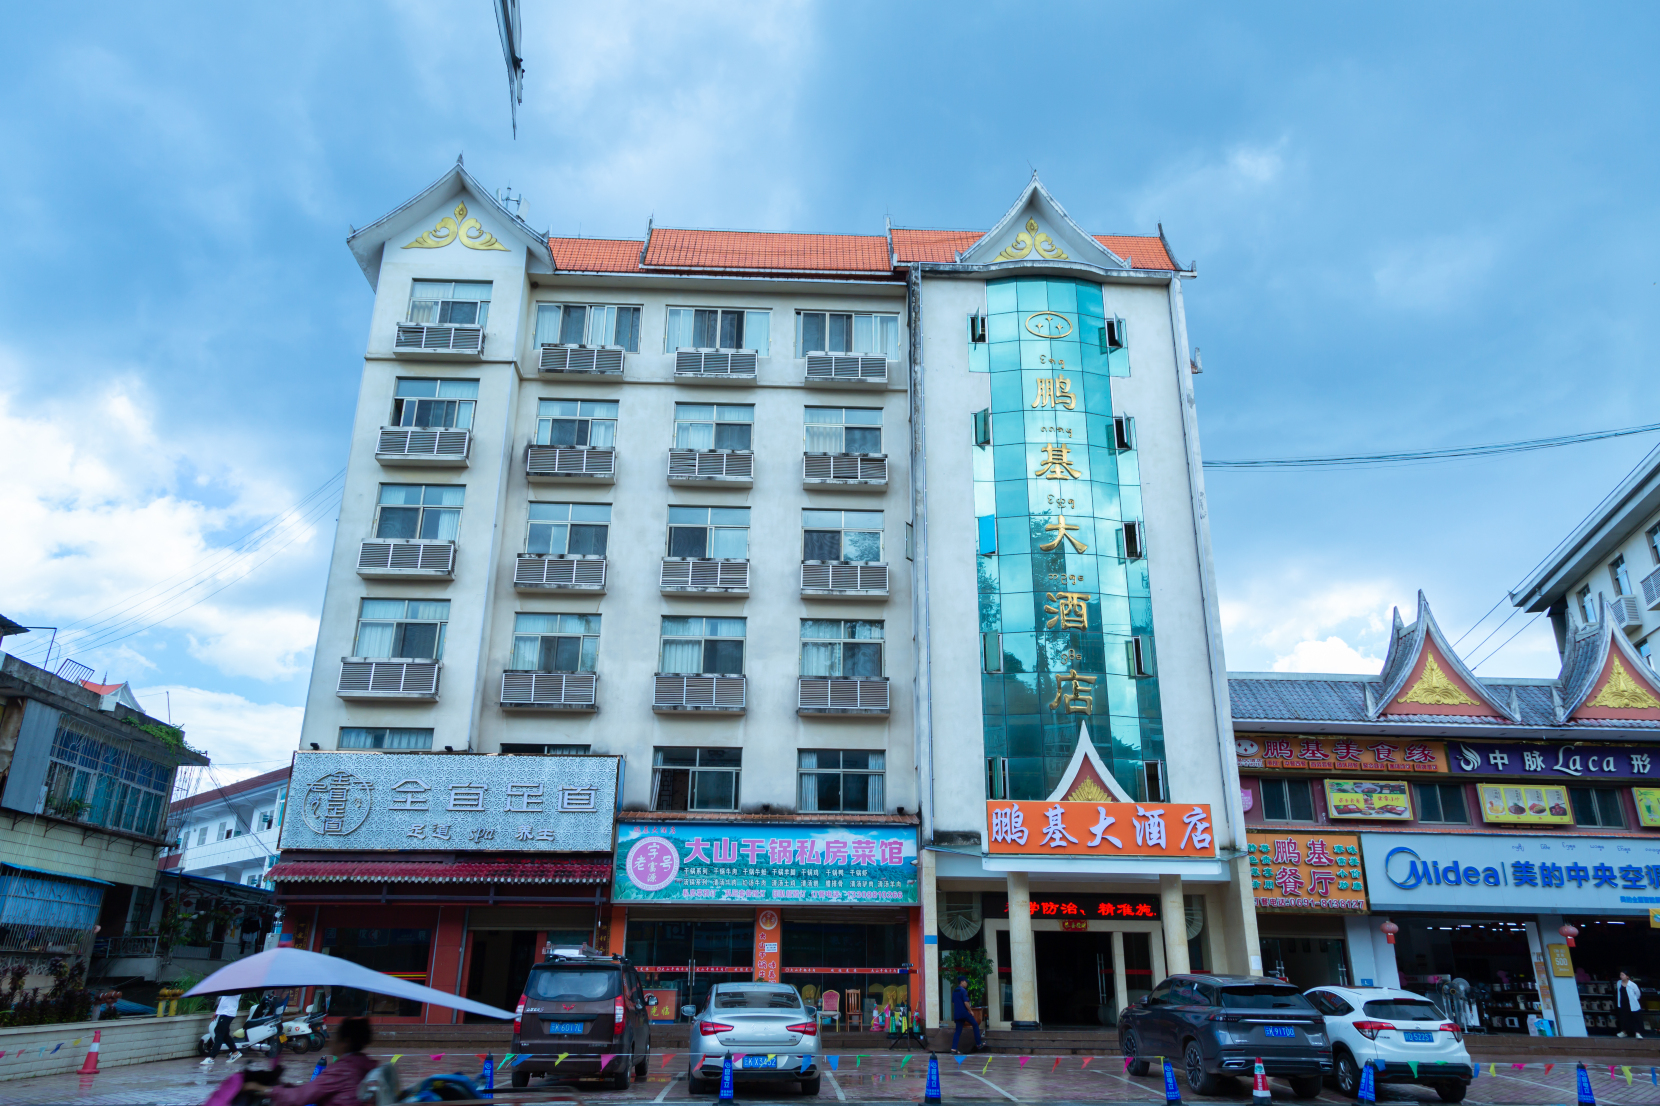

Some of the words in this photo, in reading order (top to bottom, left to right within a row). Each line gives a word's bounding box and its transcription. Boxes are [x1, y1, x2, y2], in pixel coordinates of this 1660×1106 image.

[1031, 373, 1097, 715] 鹏基大酒店
[1263, 739, 1436, 762] 鹏基美食缘
[1488, 749, 1545, 772] 中脉
[1630, 753, 1651, 774] 形
[991, 803, 1213, 851] 鹏基大酒店
[684, 837, 904, 866] 大山干锅私房菜馆
[1273, 837, 1335, 866] 鹏基
[847, 890, 903, 898] 13308810266
[1275, 866, 1336, 896] 餐厅
